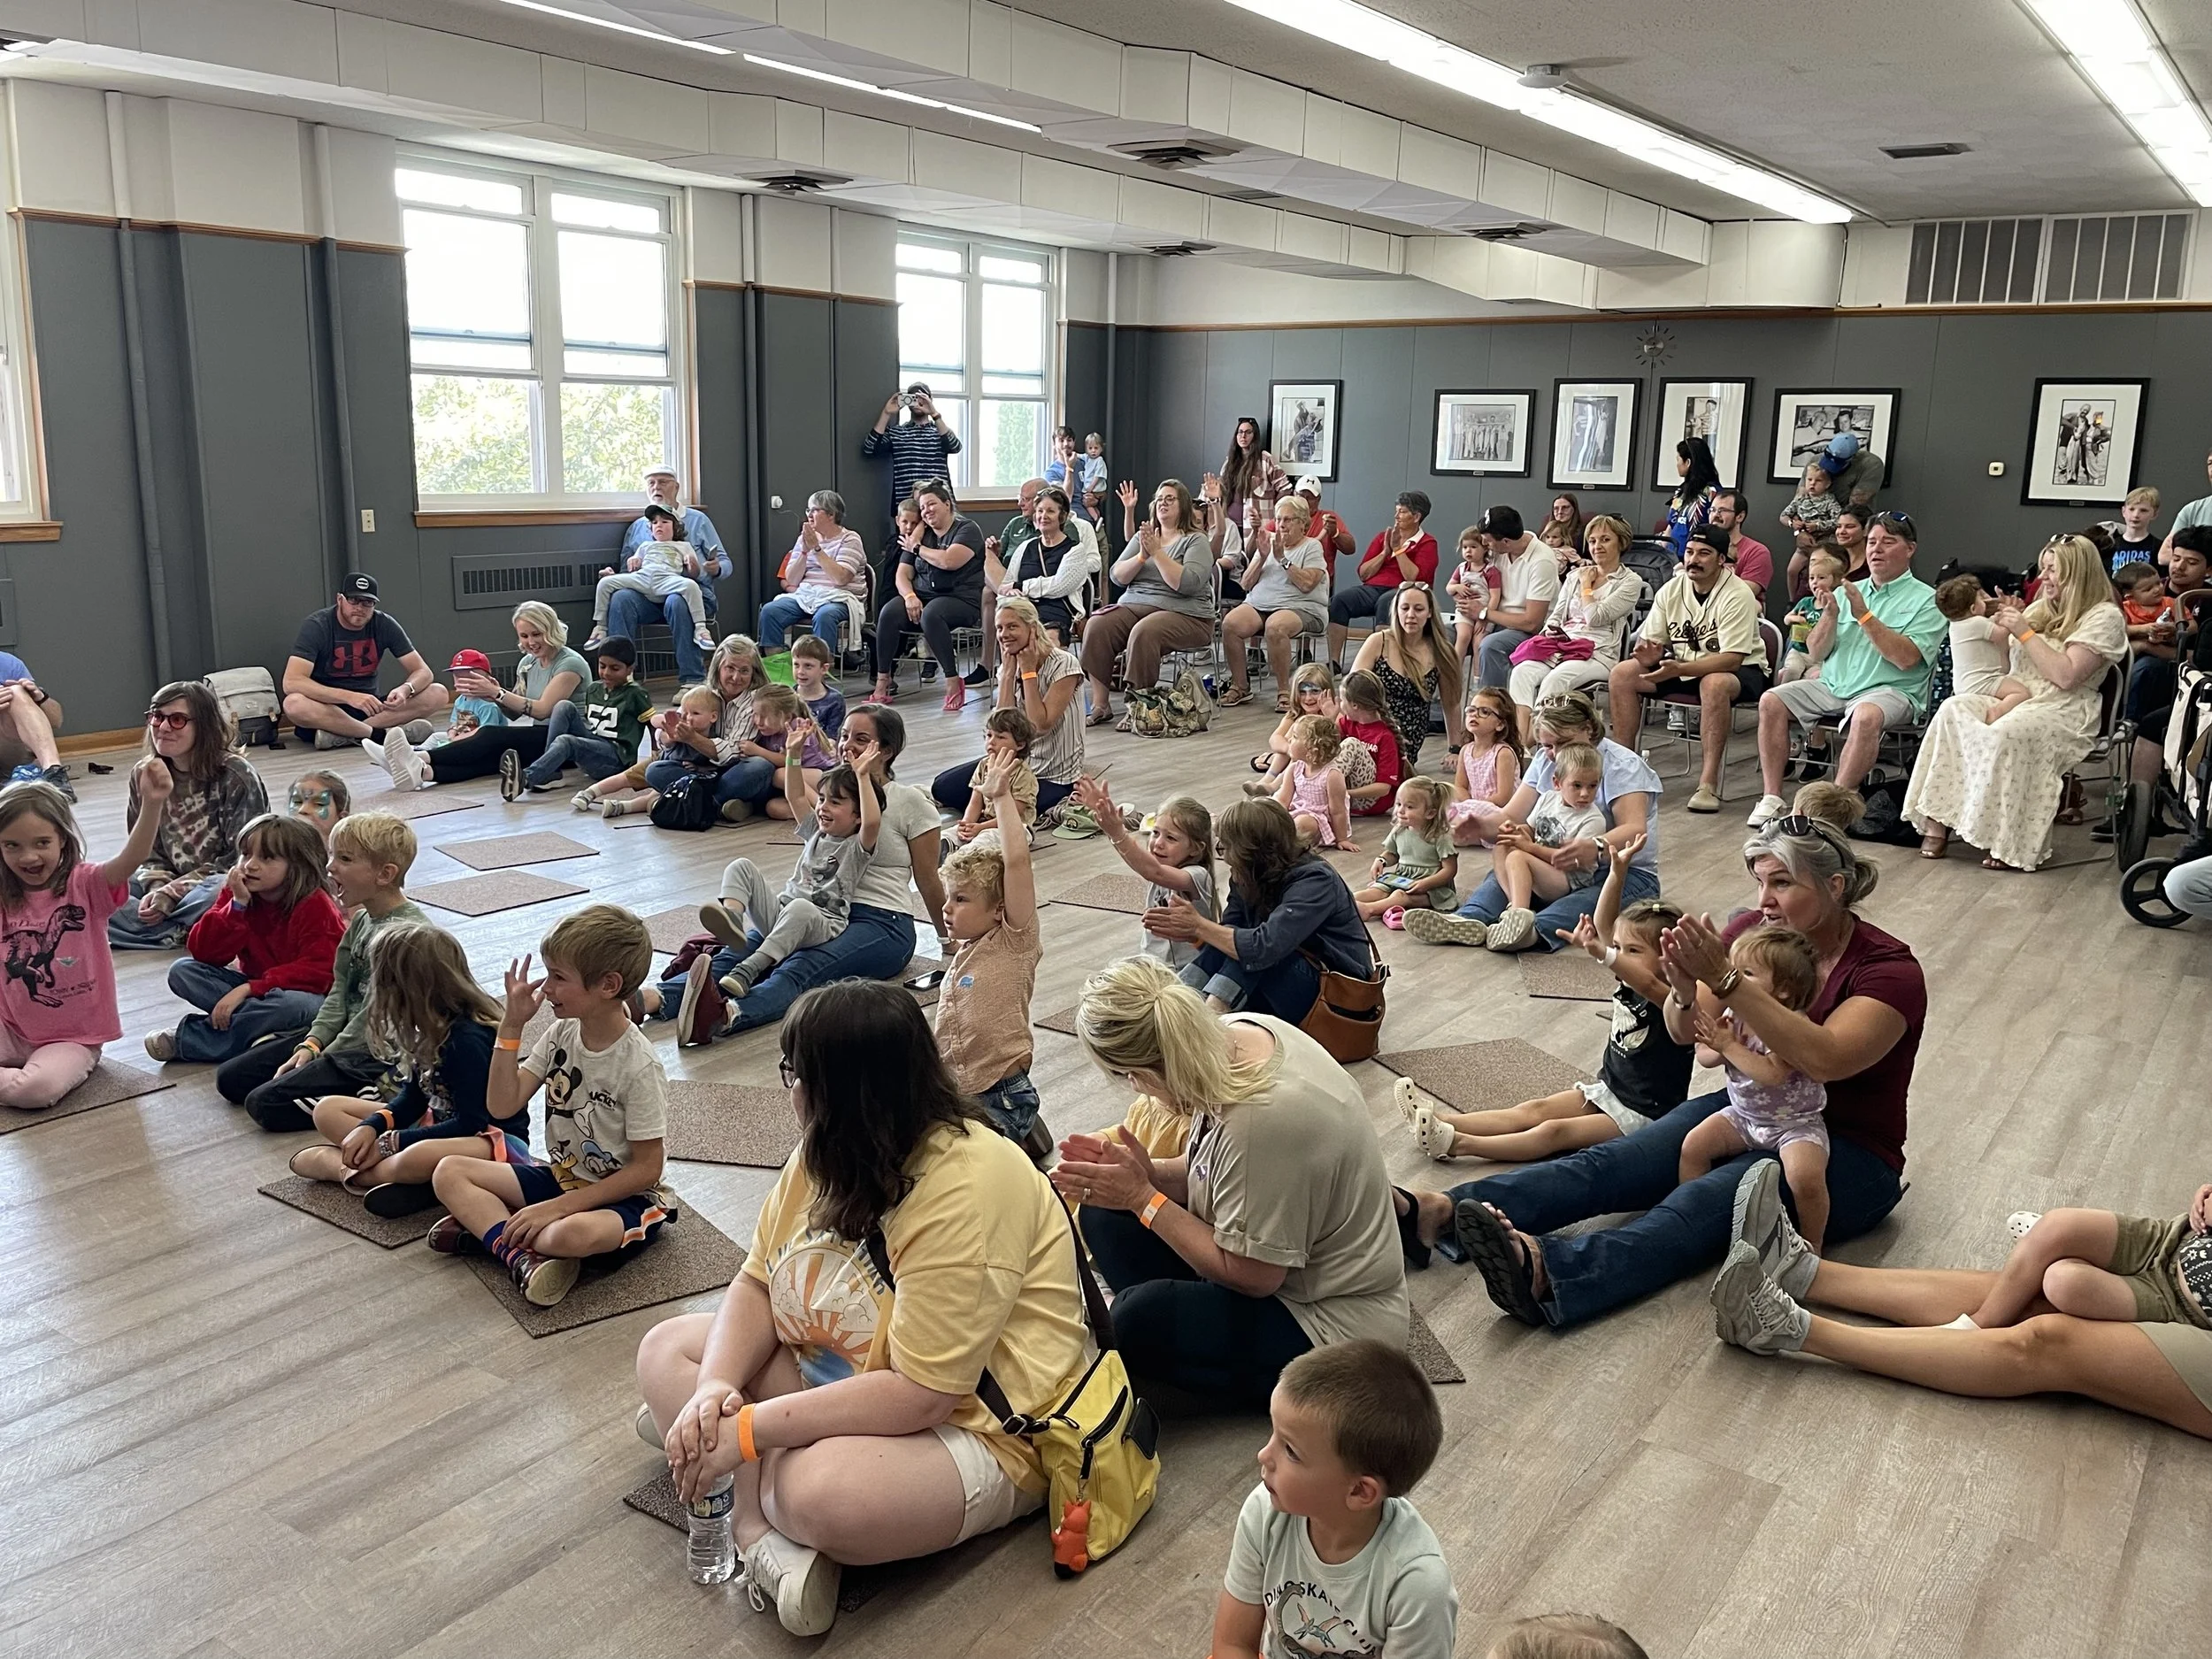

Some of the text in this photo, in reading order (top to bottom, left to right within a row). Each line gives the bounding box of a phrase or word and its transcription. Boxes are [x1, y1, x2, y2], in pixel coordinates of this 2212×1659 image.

[2112, 550, 2151, 560] ADIDAS
[585, 703, 618, 738] 52
[1299, 1581, 1341, 1613] SKA
